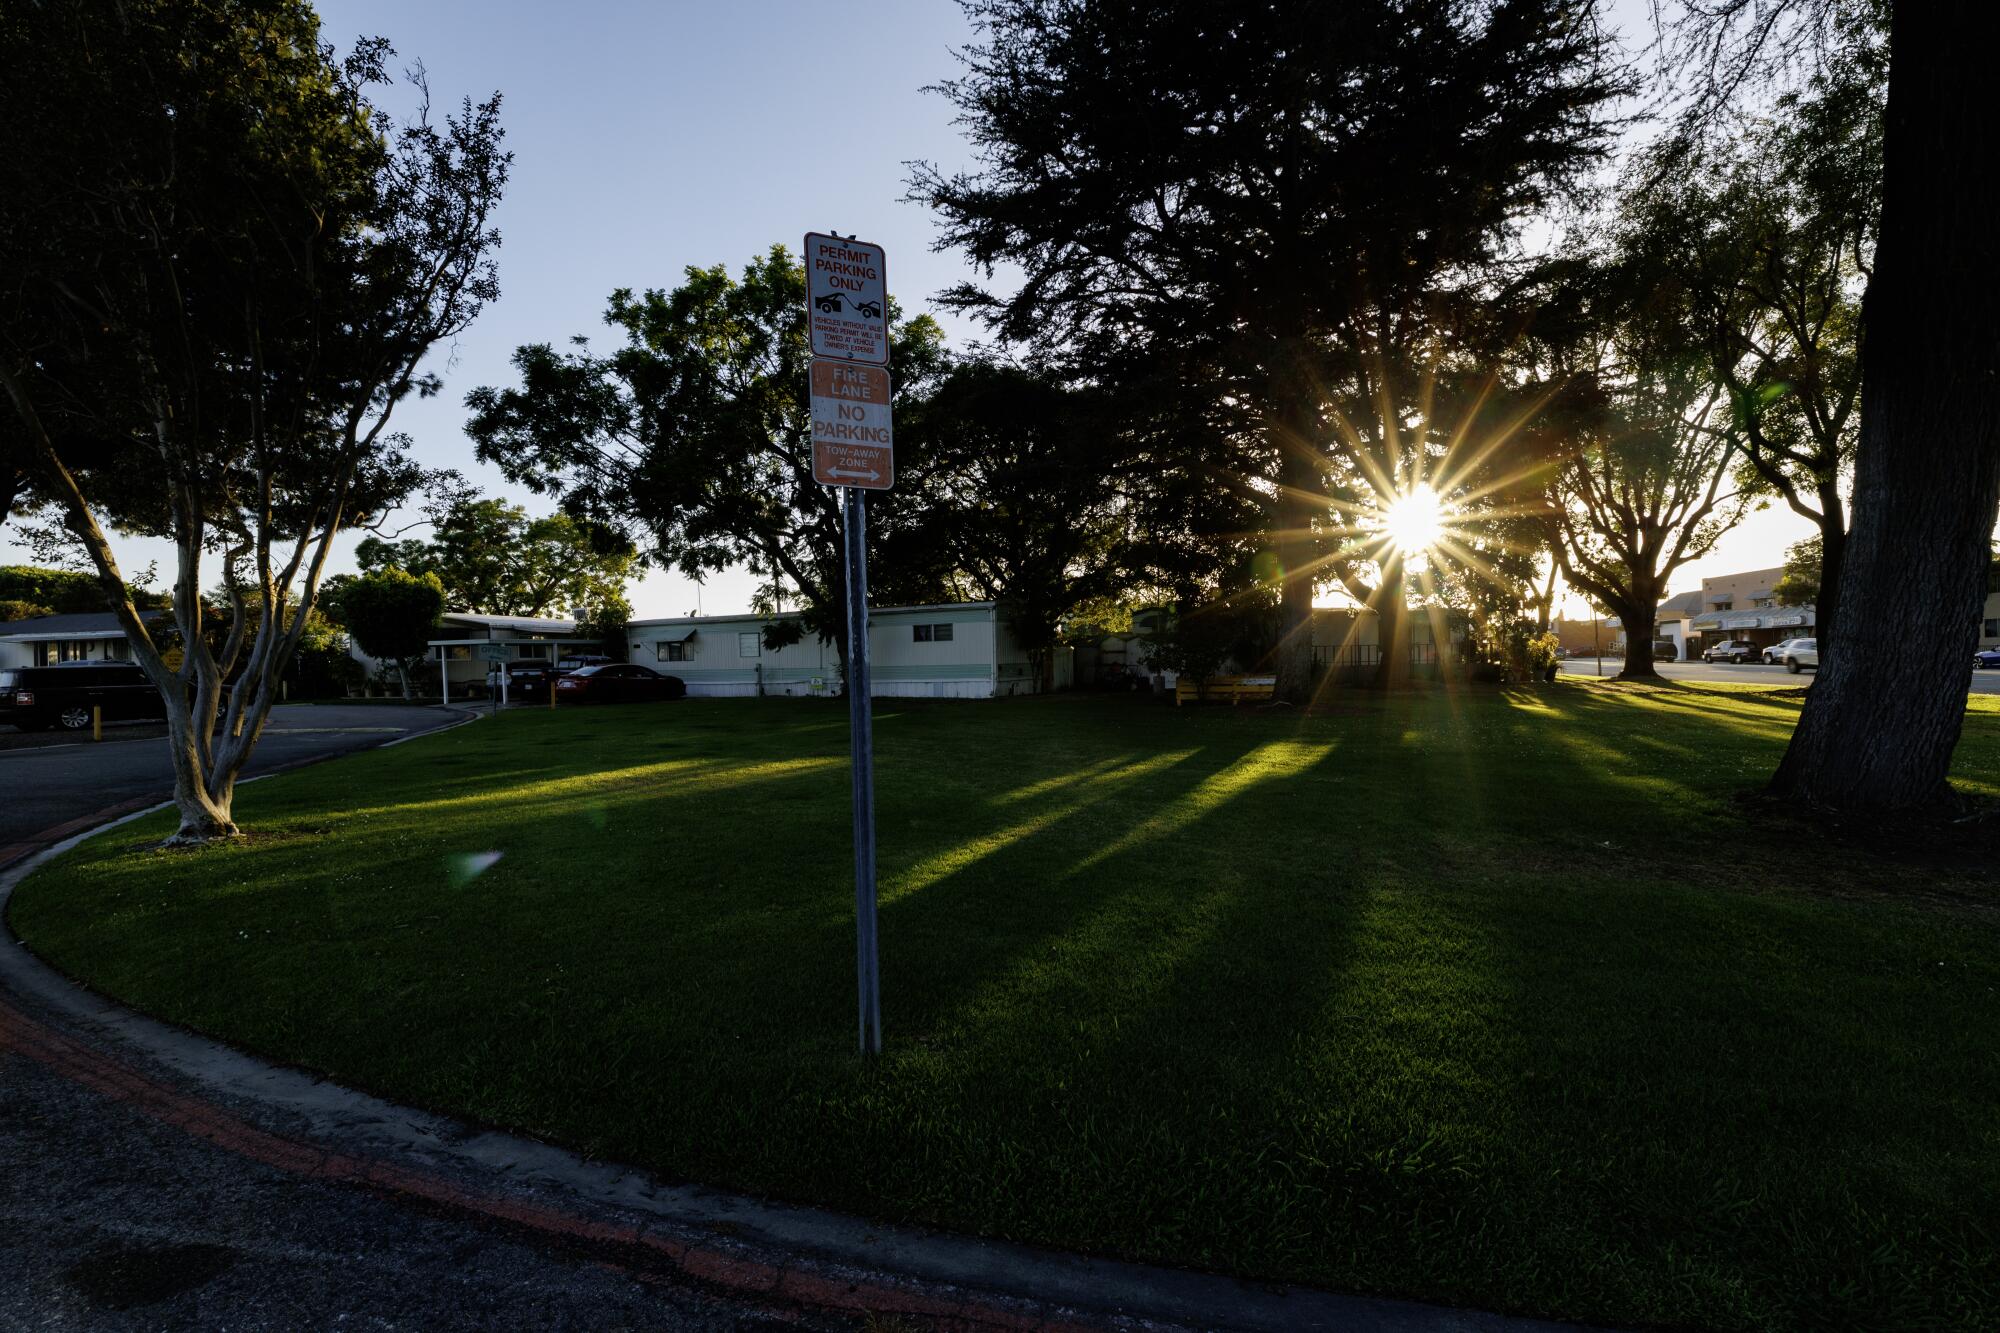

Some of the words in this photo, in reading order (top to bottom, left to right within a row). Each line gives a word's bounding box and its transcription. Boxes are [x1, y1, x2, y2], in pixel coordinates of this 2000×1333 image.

[819, 245, 871, 264] PERMIT
[816, 258, 876, 280] PARKING
[829, 275, 864, 291] ONLY
[815, 324, 839, 333] PARKING
[840, 328, 860, 336] PERMIT
[842, 320, 866, 329] WITHOUT
[824, 333, 843, 342] TOWED
[853, 338, 875, 346] VEHICLE
[850, 345, 875, 354] EXPENSE
[833, 368, 868, 383] FIRE
[832, 382, 871, 398] LANE
[838, 403, 865, 421] NO
[814, 420, 889, 444] PARKING
[839, 457, 868, 467] ZONE
